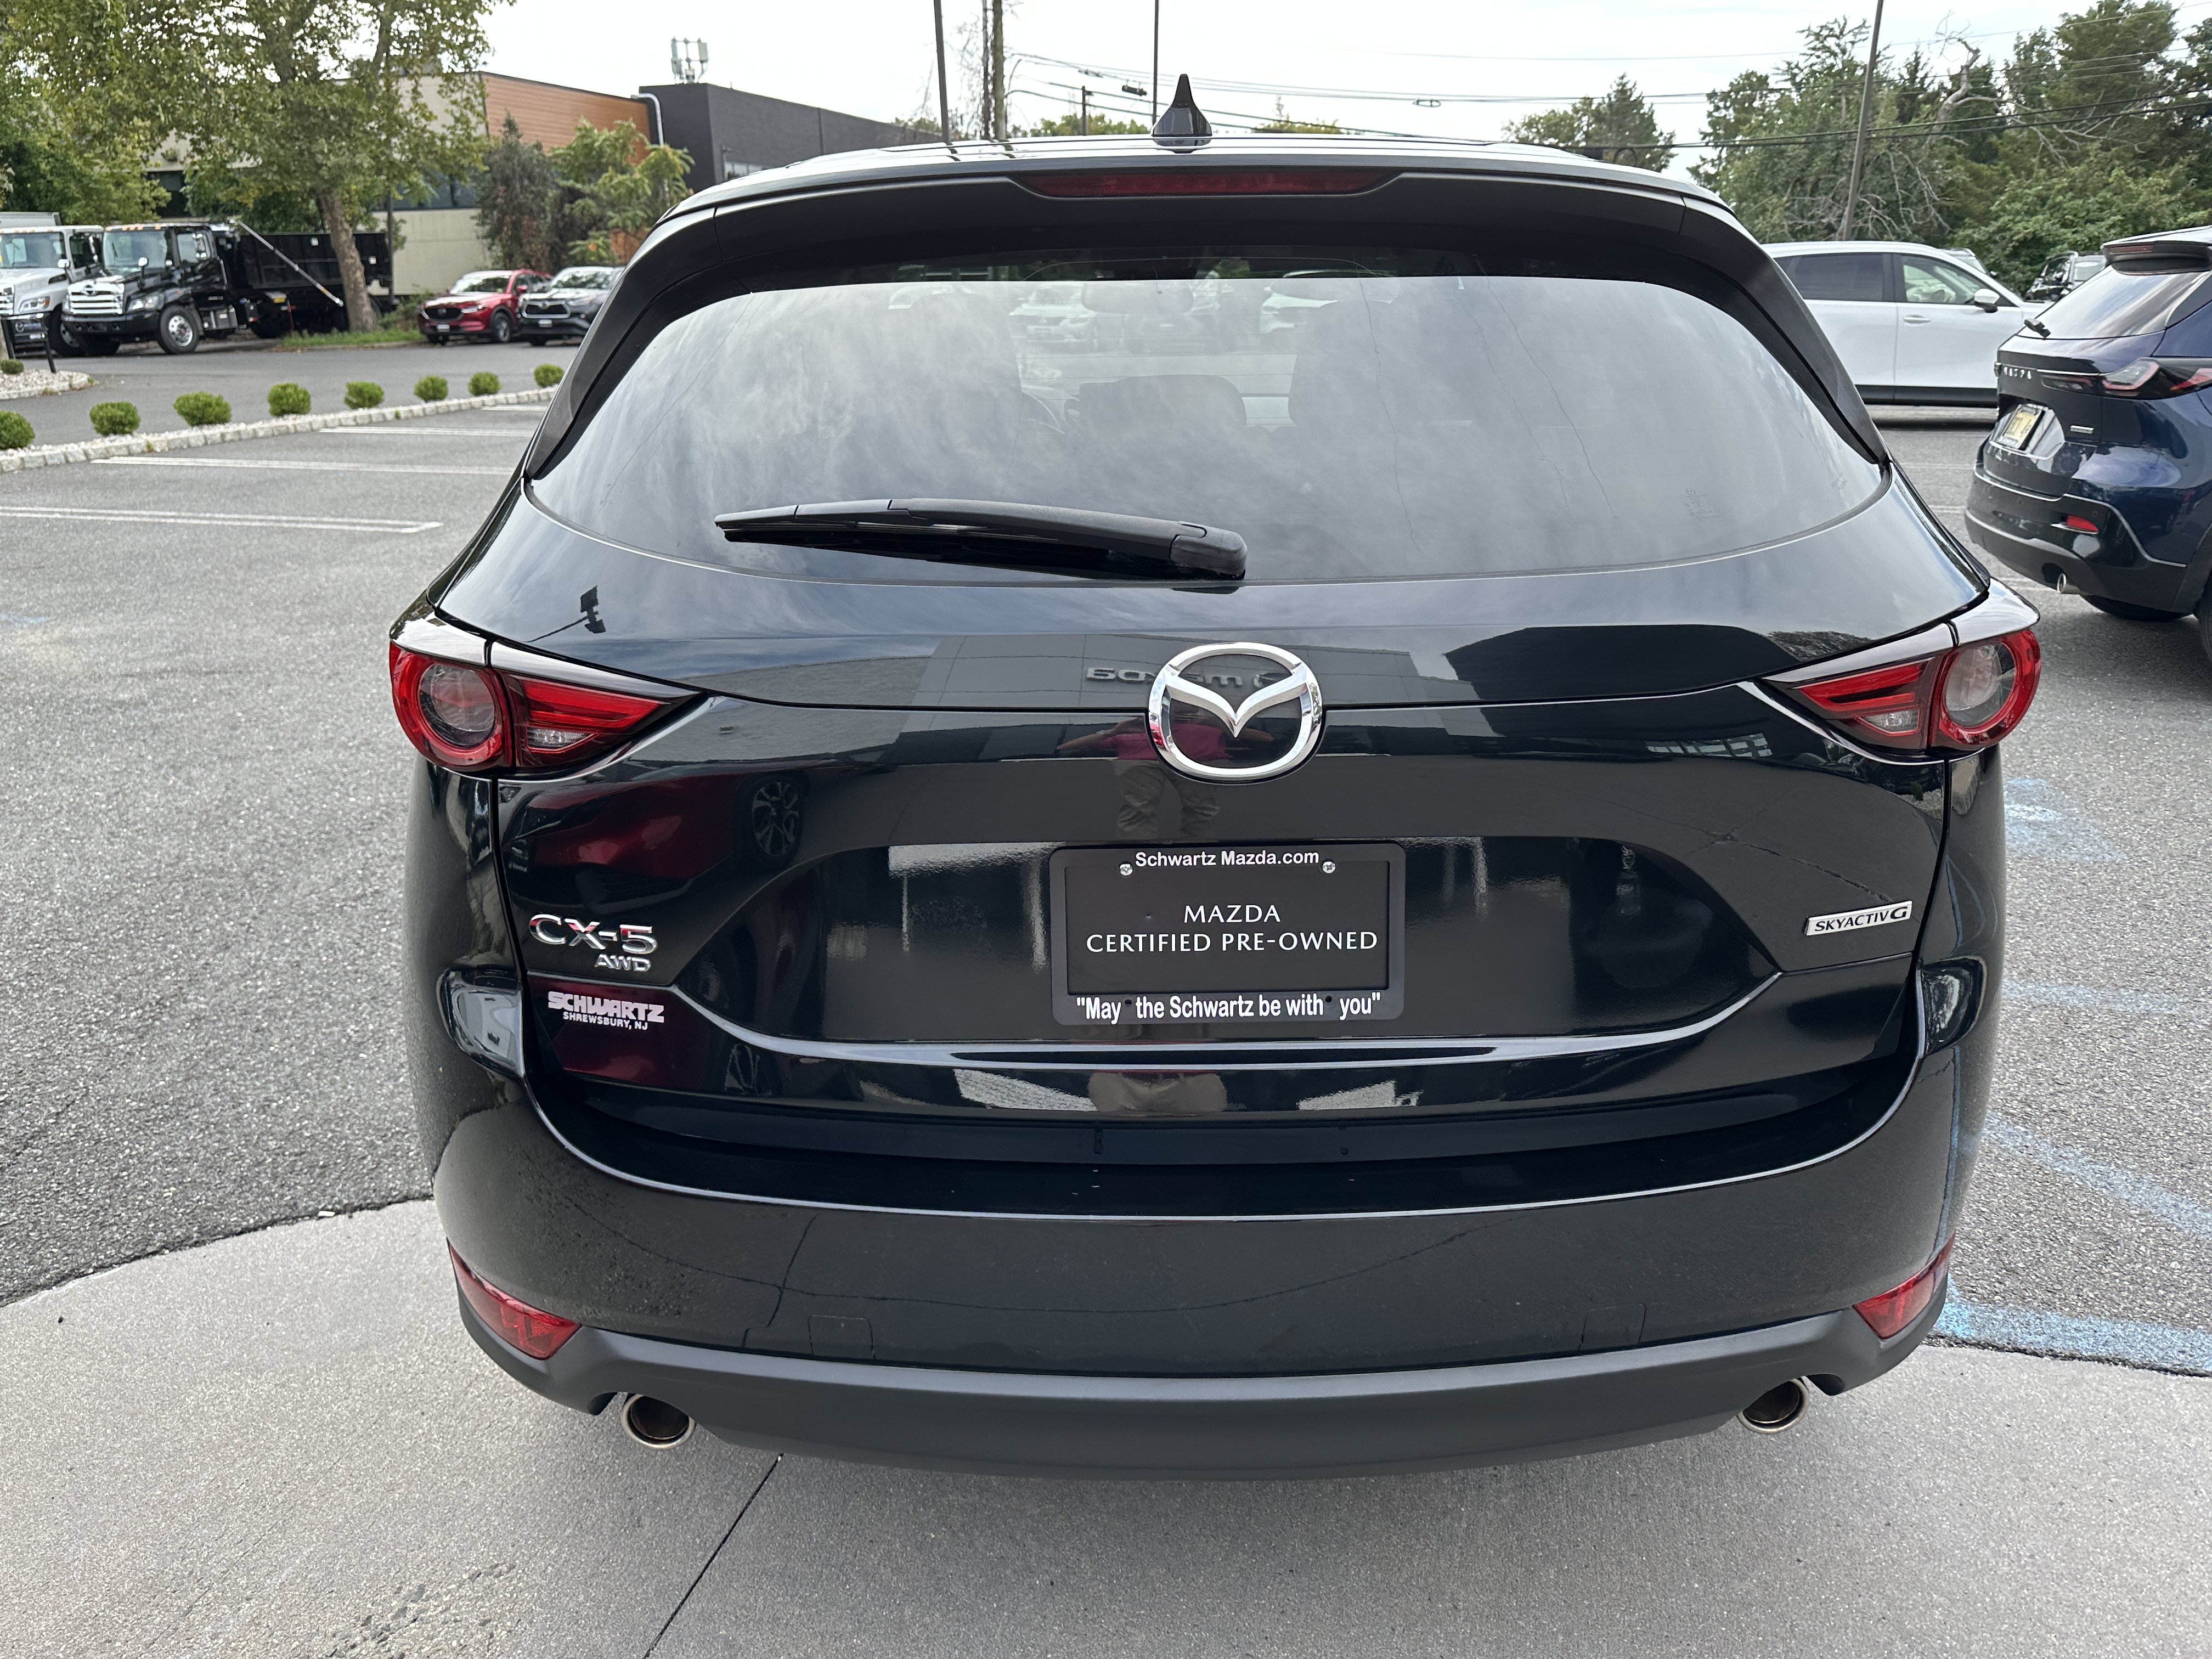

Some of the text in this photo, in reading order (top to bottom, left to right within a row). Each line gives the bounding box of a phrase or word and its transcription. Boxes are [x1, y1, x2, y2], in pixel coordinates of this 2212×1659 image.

[1135, 850, 1319, 867] Schwartz Mazda.com
[1183, 905, 1281, 923] MAZDA
[1815, 911, 1889, 932] SKYACTIV
[528, 914, 658, 954] CX-5
[1086, 931, 1378, 952] CERTIFIED PRE-OWNED
[594, 953, 652, 972] AWD
[548, 991, 664, 1023] SCHWARTZ
[1076, 992, 1381, 1024] "May the Schwartz be with you"
[563, 1012, 648, 1030] SHREWSBURY, NJ
